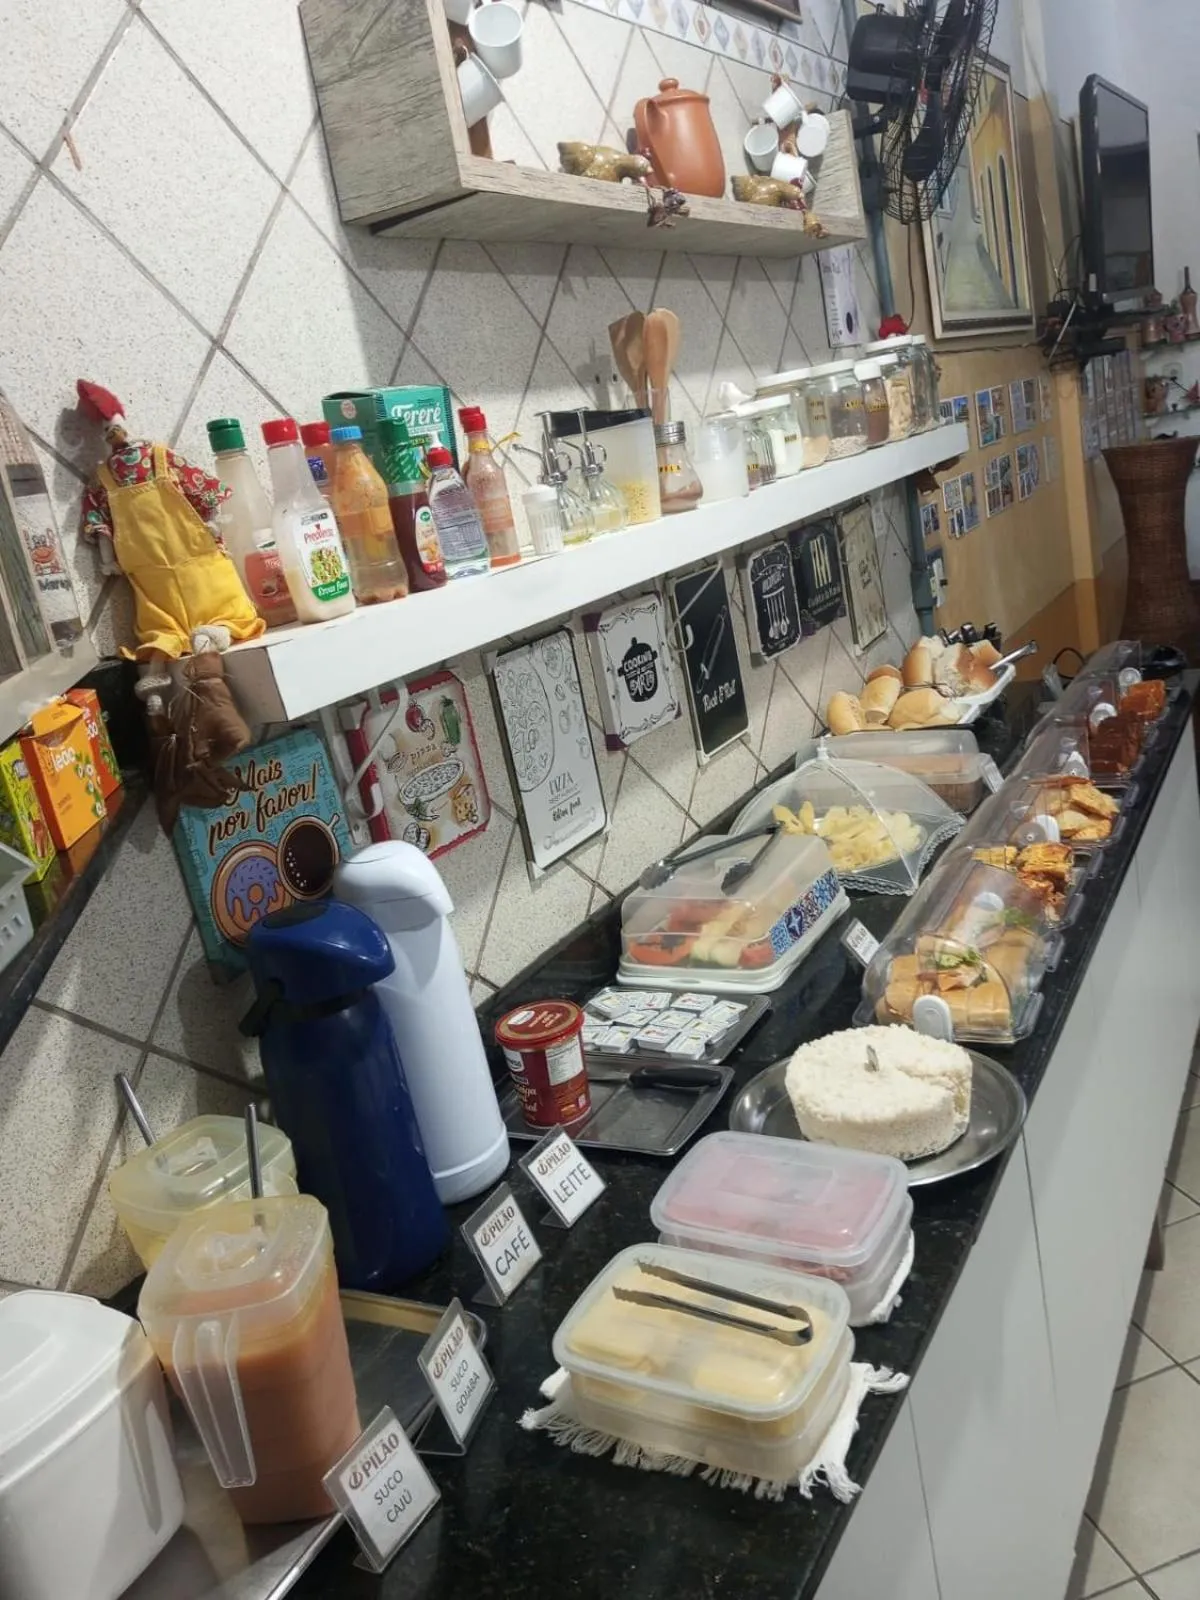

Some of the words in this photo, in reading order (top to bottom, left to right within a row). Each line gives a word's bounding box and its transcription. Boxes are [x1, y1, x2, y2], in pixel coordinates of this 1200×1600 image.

[390, 402, 442, 427] Tereré
[227, 759, 283, 803] Mais
[208, 810, 249, 857] por
[255, 763, 320, 833] favor!
[547, 1142, 572, 1169] PILÃO
[552, 1162, 591, 1204] LEITE
[488, 1206, 515, 1239] PILÃO
[495, 1225, 530, 1276] CAFÉ
[439, 1326, 464, 1368] PILÃO
[450, 1359, 469, 1392] SUCO
[455, 1371, 480, 1414] GOIABA
[361, 1432, 400, 1478] PILÃO
[373, 1469, 403, 1505] SUCO
[386, 1489, 413, 1523] CAJÚ
